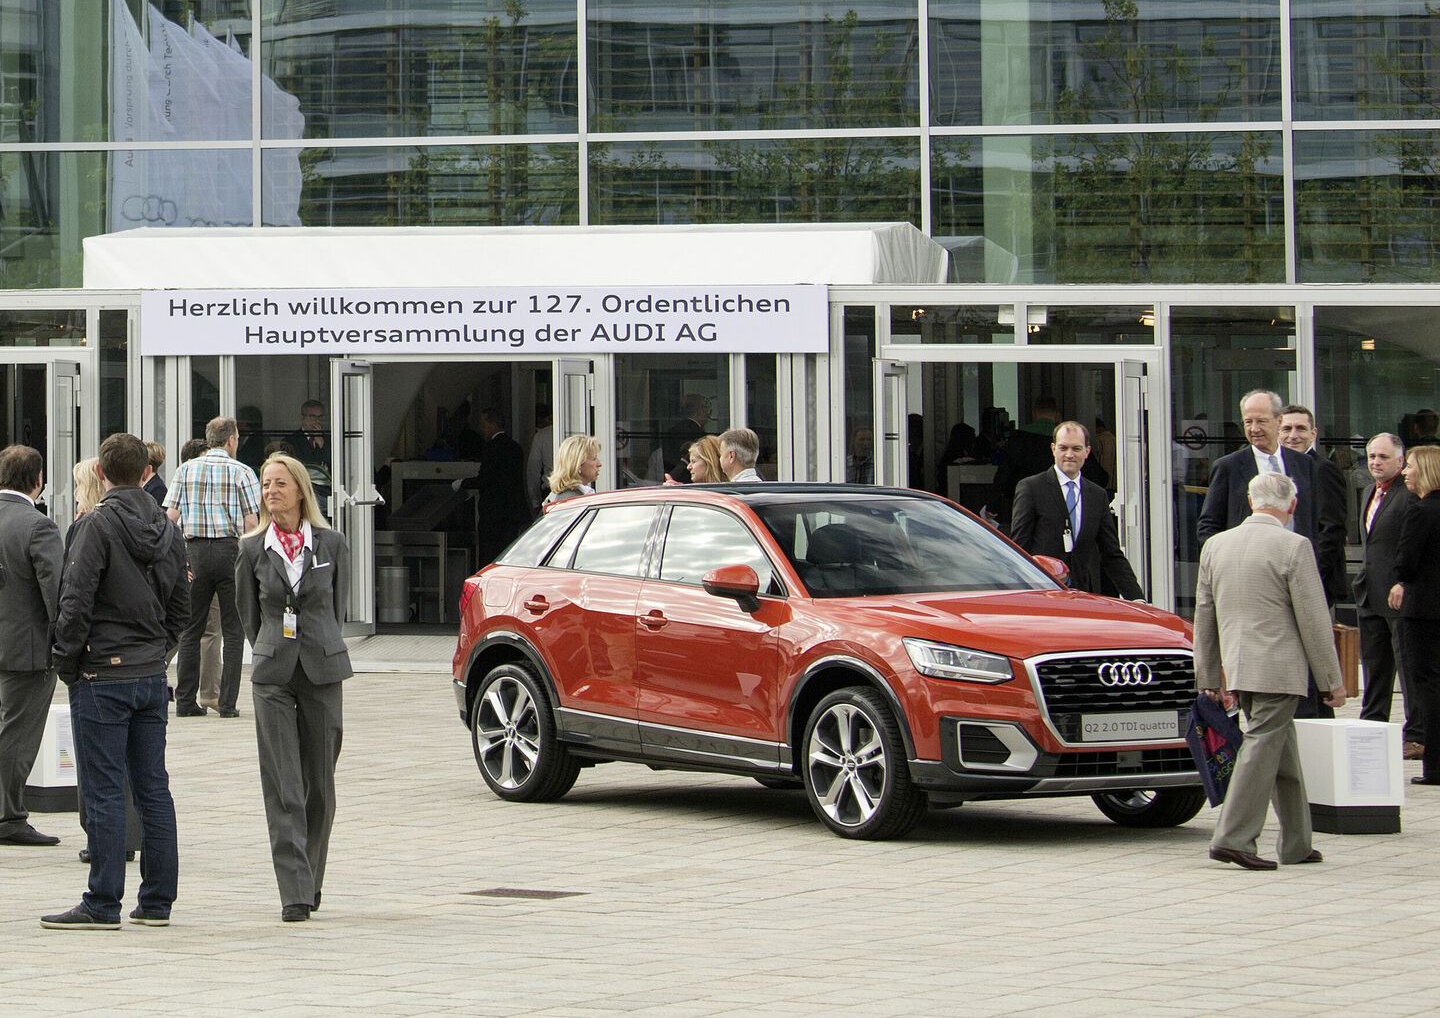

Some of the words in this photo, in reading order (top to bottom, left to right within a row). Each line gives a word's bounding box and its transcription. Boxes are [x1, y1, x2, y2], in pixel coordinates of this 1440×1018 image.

[169, 297, 279, 317] Herzlich
[287, 296, 463, 315] willkommen
[472, 300, 517, 314] zur
[529, 294, 591, 314] 127.
[601, 294, 790, 313] Ordentlichen
[245, 324, 525, 348] Hauptversammlung
[535, 323, 582, 342] der
[590, 323, 666, 342] AUDI
[675, 322, 718, 342] AG
[1084, 723, 1099, 734] Q2
[1102, 722, 1119, 733] 2.0
[1121, 722, 1138, 732] TDI
[1140, 721, 1177, 733] quattro
